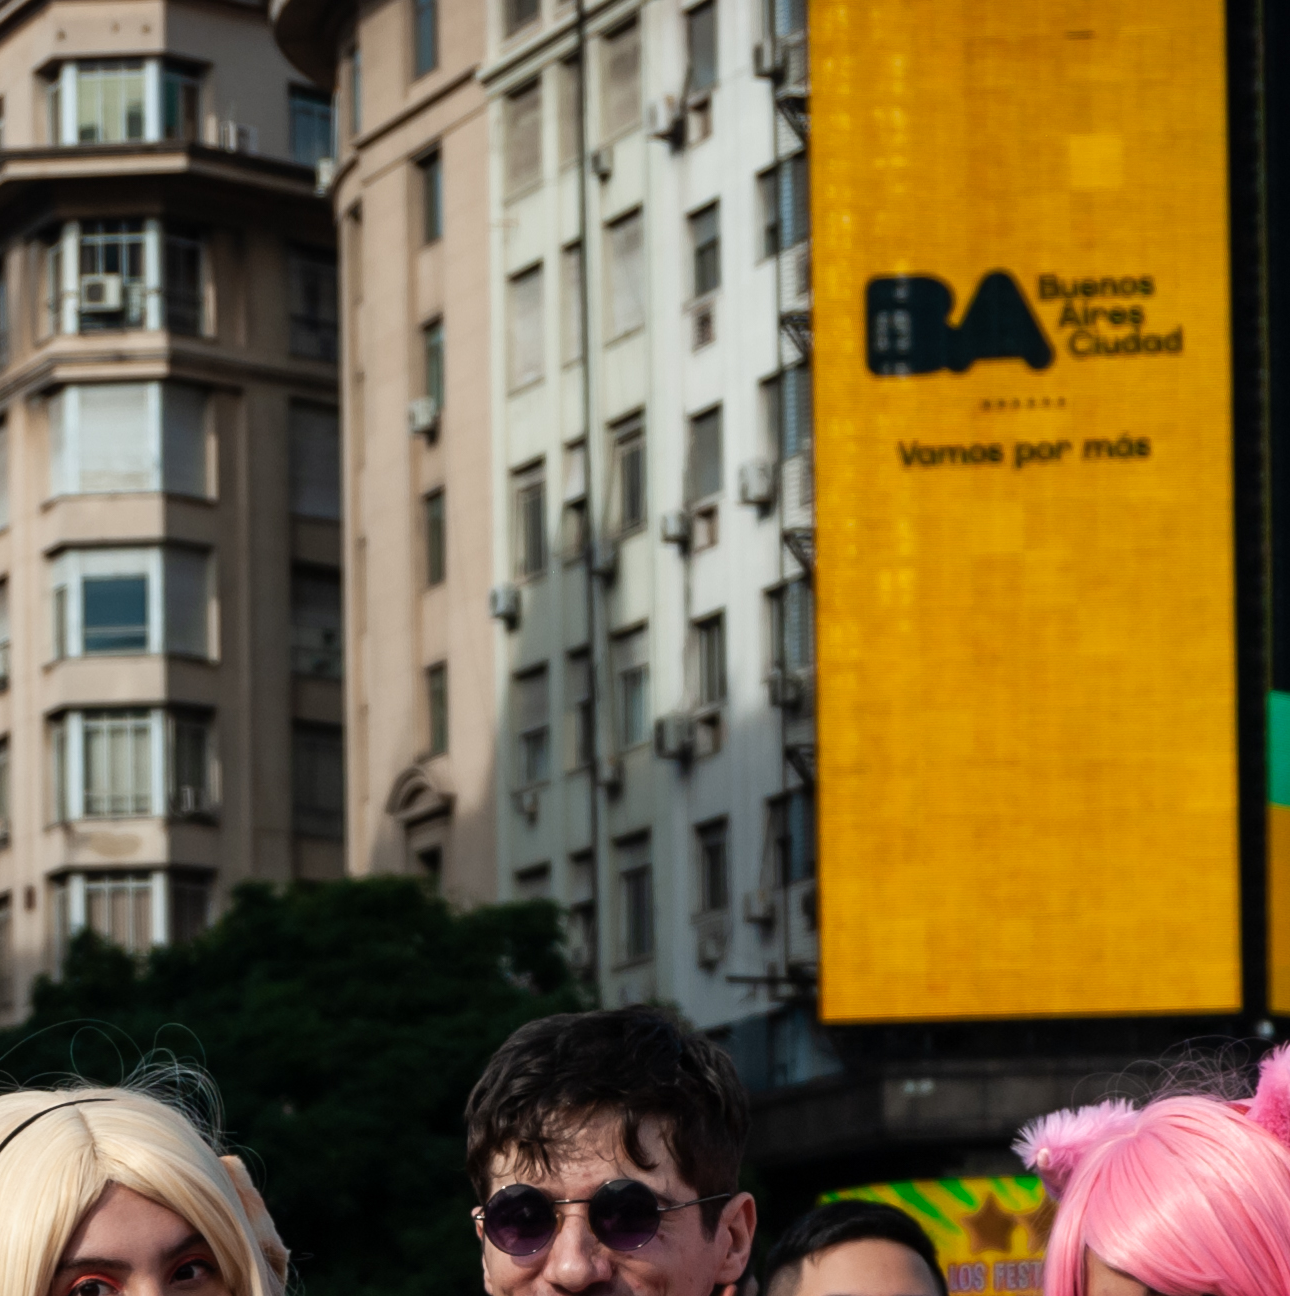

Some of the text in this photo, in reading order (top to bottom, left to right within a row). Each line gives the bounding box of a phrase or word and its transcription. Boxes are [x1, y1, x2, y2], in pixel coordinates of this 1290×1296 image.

[1038, 273, 1155, 300] Buenos
[865, 268, 1056, 378] BA
[1059, 303, 1145, 327] Aires
[1067, 324, 1183, 357] Ciudad
[898, 431, 1152, 469] Vamos por más
[949, 1262, 985, 1290] LOS
